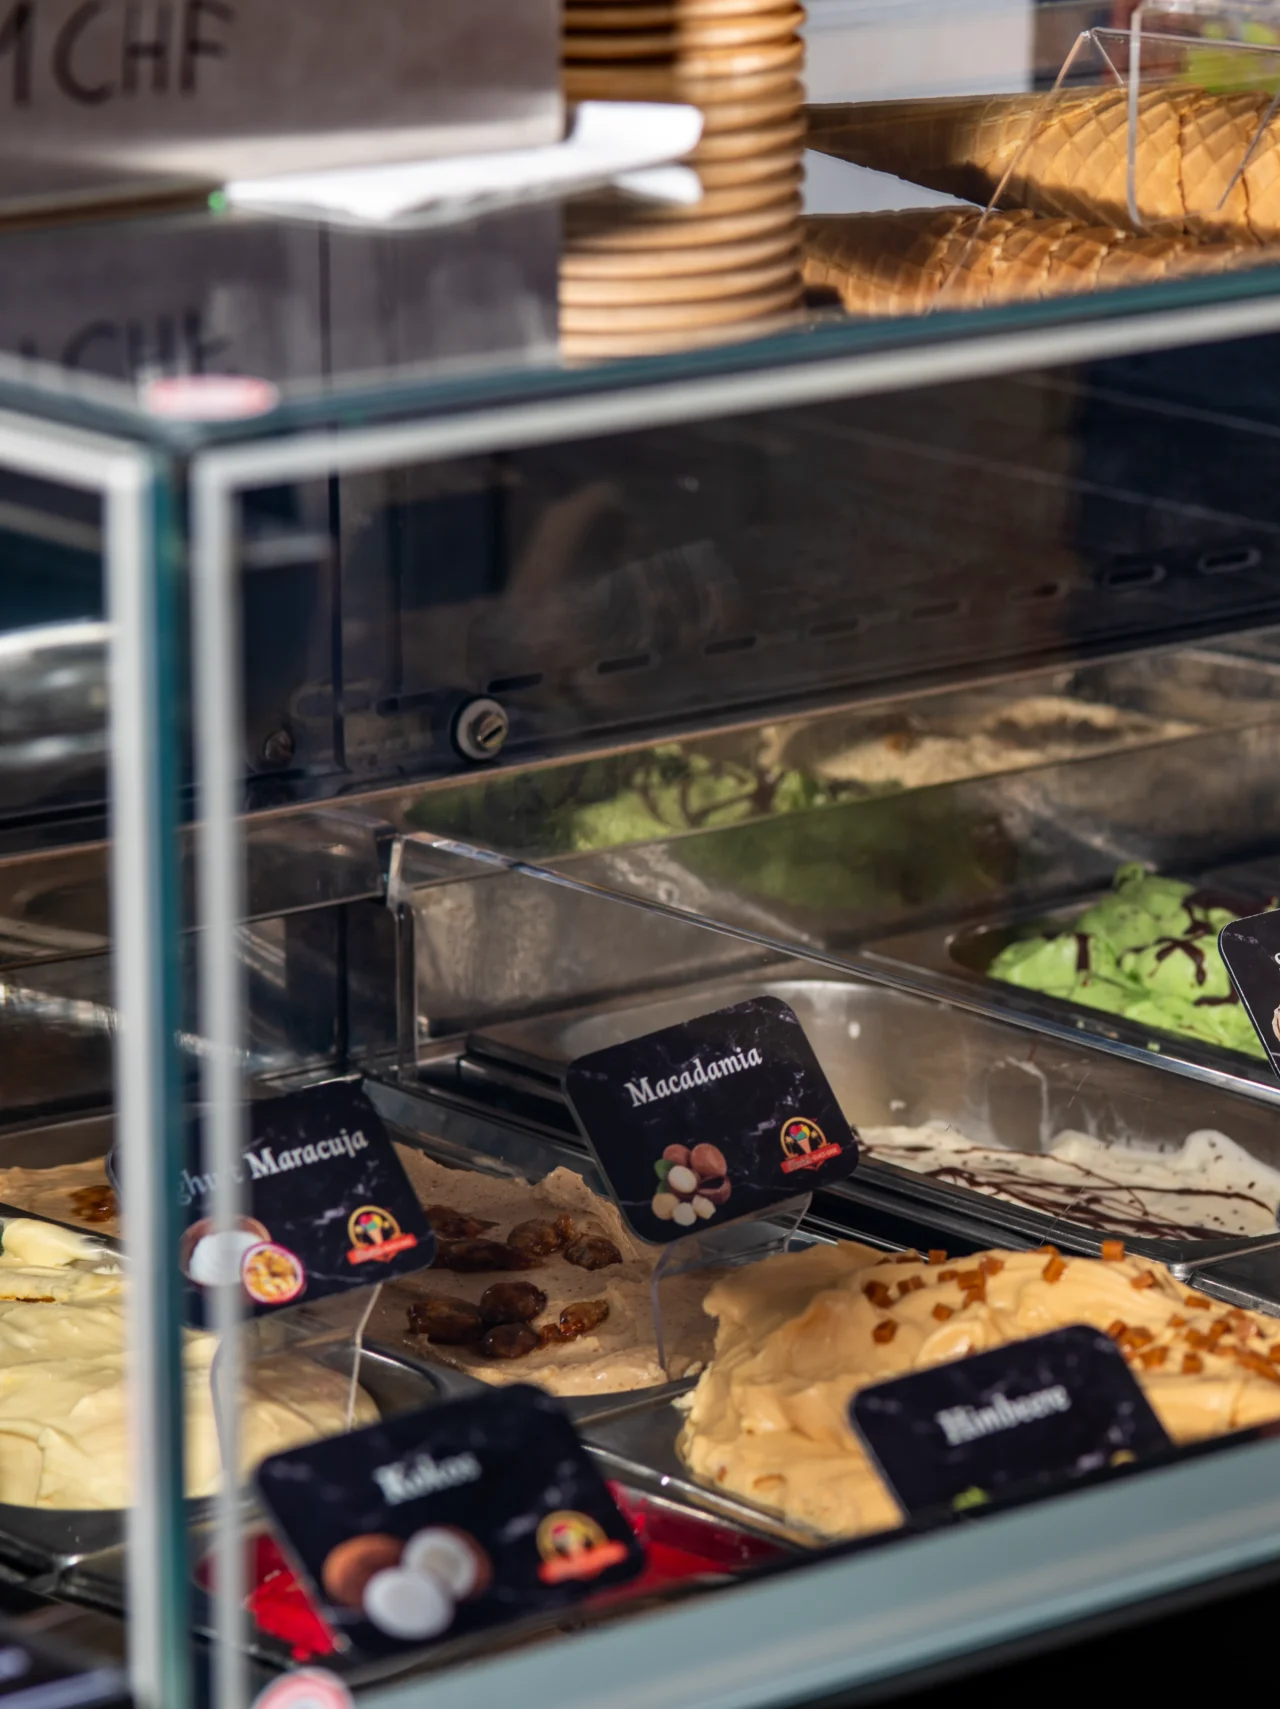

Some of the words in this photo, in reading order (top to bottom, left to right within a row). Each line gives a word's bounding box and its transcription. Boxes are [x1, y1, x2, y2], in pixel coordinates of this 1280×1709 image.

[52, 0, 238, 107] CHF
[623, 1047, 763, 1107] Macadamia
[243, 1128, 369, 1180] Maracuja
[372, 1452, 483, 1506] Kokos
